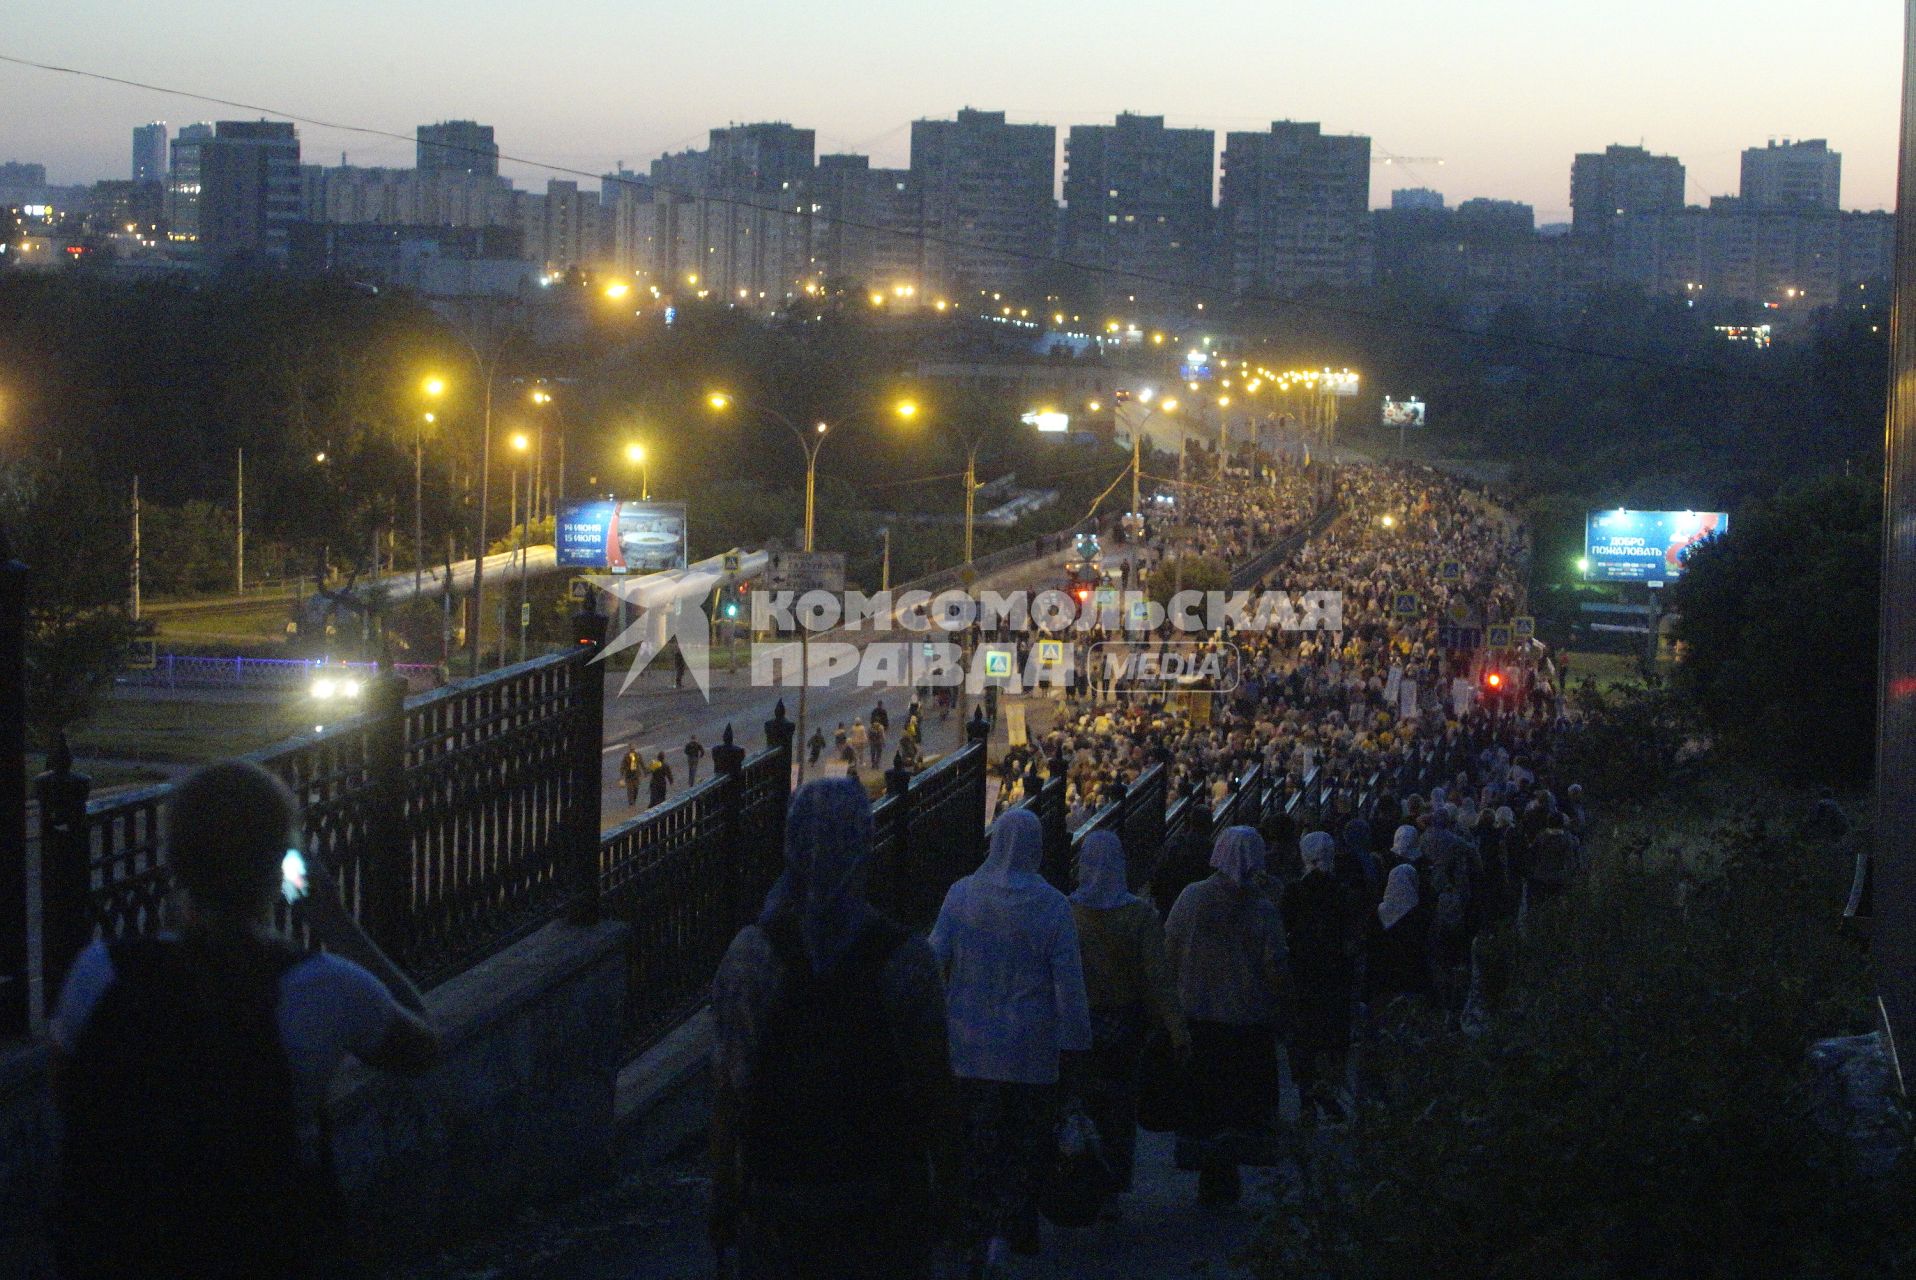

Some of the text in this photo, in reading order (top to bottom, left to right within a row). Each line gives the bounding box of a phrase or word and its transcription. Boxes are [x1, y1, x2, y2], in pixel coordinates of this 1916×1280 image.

[574, 524, 601, 532] ИЮНЯ
[565, 534, 601, 542] 15 ИЮЛЯ
[1610, 536, 1645, 546] ДОБРО
[1592, 546, 1662, 556] ПОЖАЛОВАТЬ
